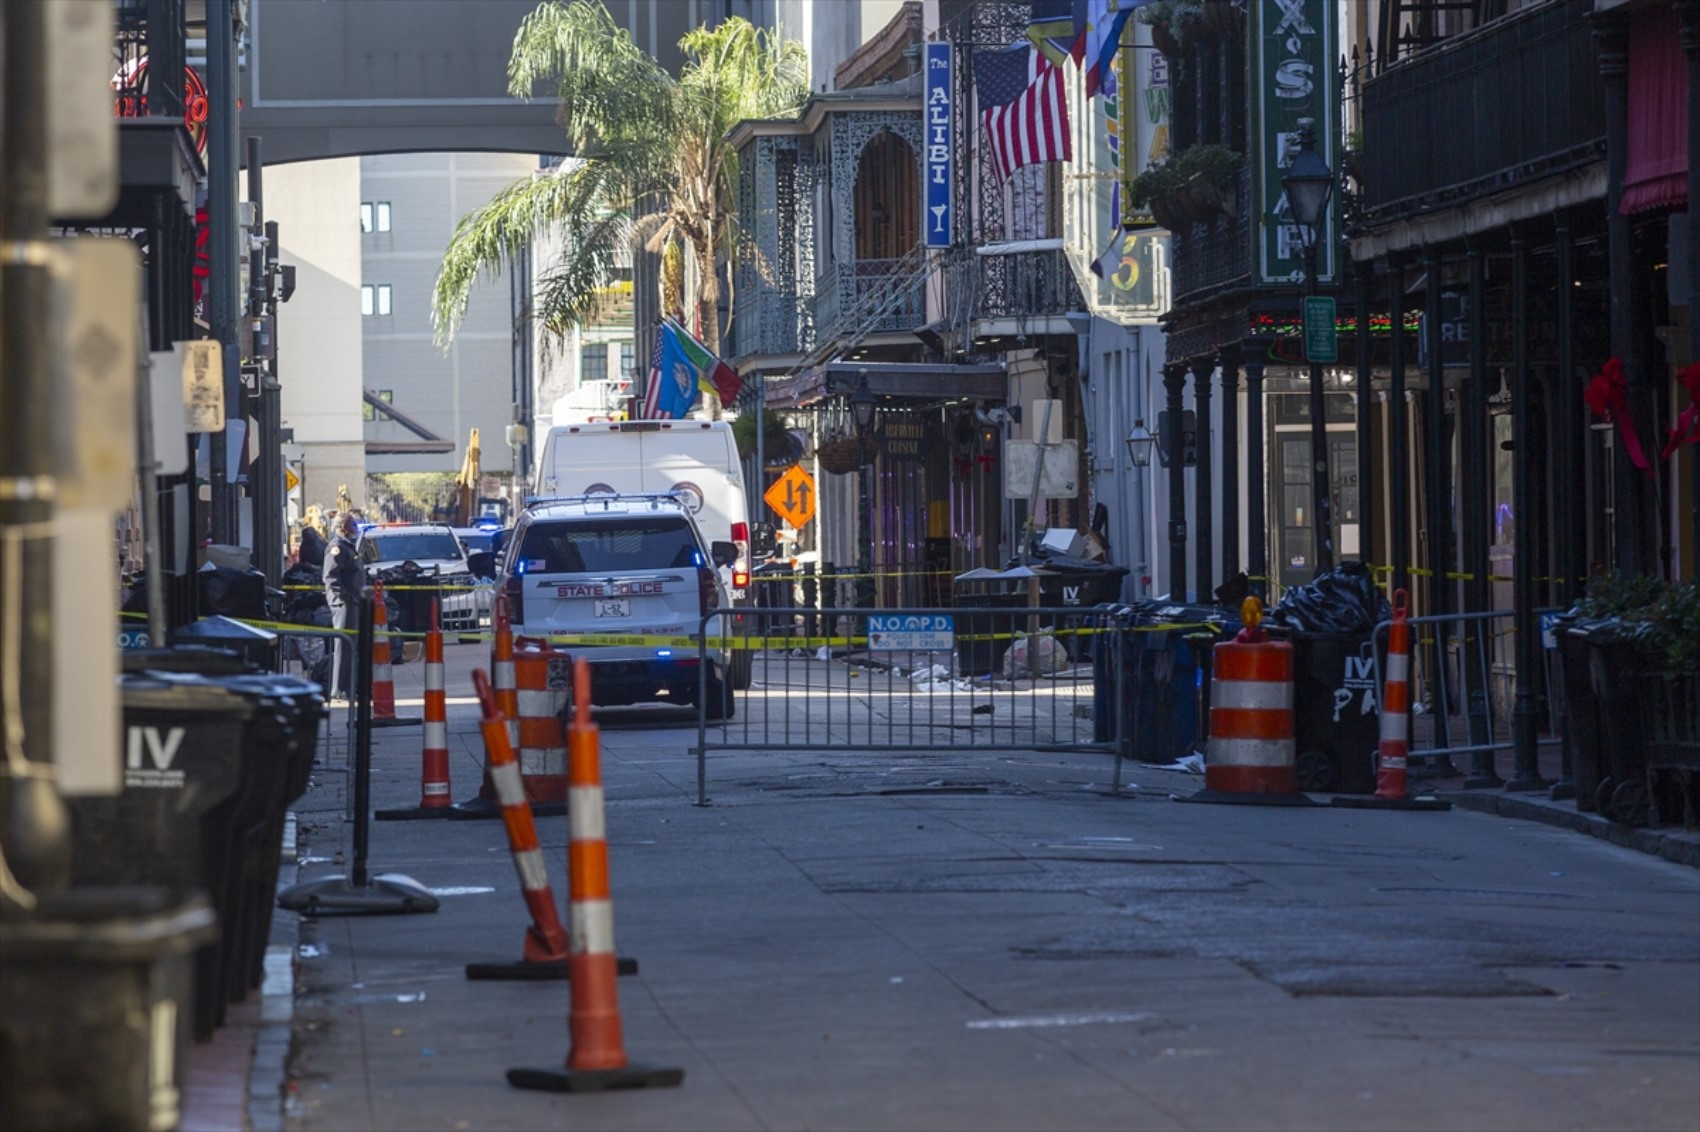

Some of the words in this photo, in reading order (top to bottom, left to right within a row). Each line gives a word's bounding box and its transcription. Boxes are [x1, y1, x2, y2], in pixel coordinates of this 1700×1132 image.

[930, 58, 948, 69] The
[929, 87, 949, 184] ALIBI
[557, 585, 603, 597] STATE
[610, 582, 663, 595] POLICE
[1063, 586, 1079, 599] IV
[919, 640, 945, 648] CROSS
[1345, 656, 1374, 679] IV
[127, 726, 185, 770] IV
